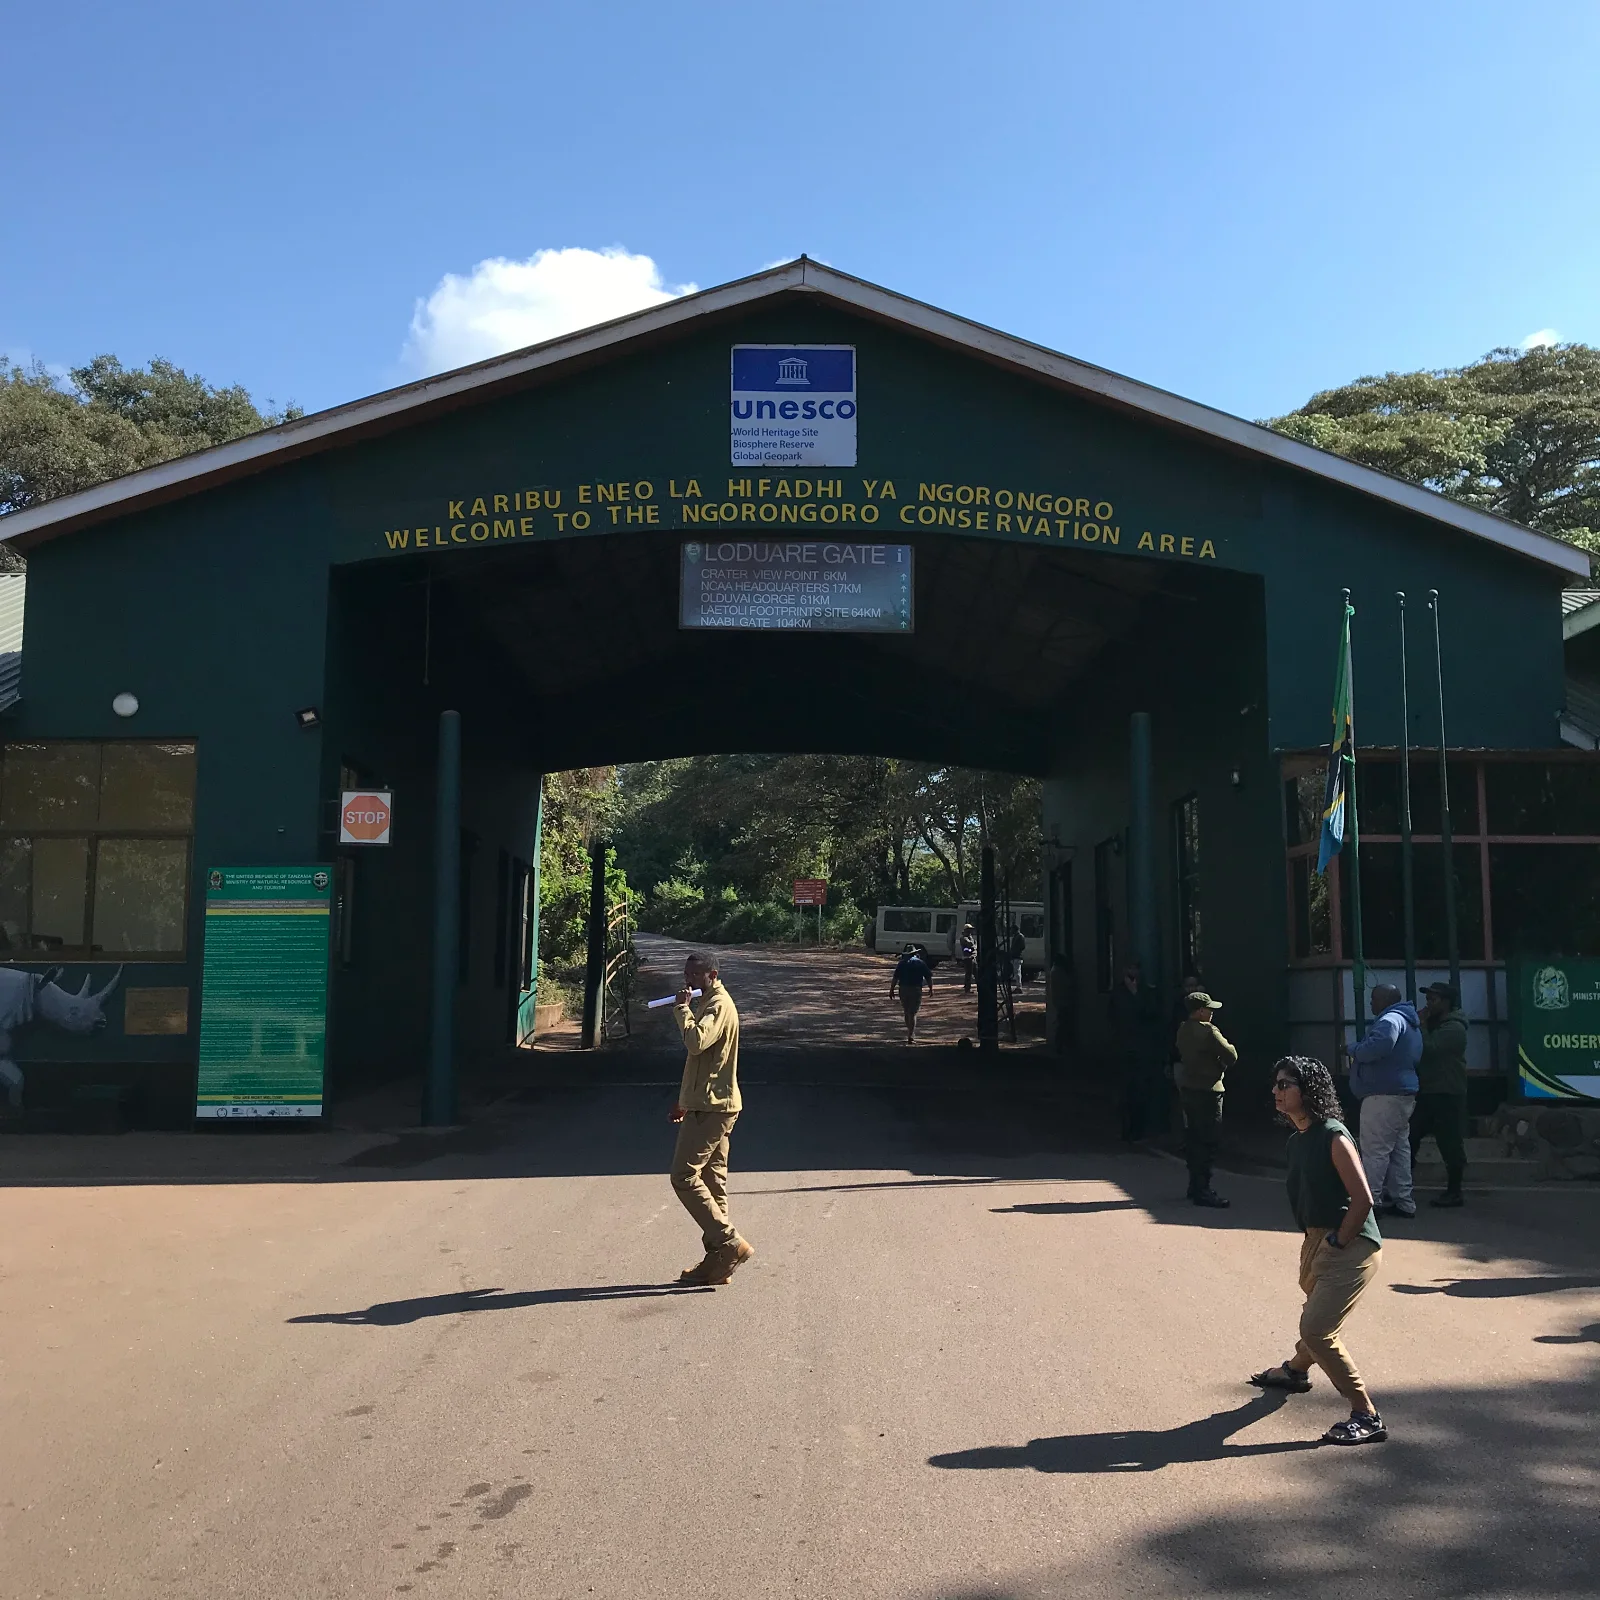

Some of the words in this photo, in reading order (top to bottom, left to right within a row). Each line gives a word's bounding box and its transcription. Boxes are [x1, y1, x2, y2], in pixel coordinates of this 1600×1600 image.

[733, 400, 856, 420] unesco
[733, 428, 759, 436] World
[762, 428, 800, 438] Heritage
[802, 428, 818, 436] Site
[734, 440, 777, 449] Biosphere
[780, 440, 814, 448] Reserve
[733, 452, 762, 460] Global
[764, 452, 802, 461] Geopark
[449, 490, 561, 519] KARIBU
[578, 480, 654, 503] ENEO
[669, 479, 702, 498] LA
[728, 479, 842, 498] HIFADHI
[862, 480, 897, 499] YA
[918, 483, 1113, 521] NGORONGORO
[384, 517, 534, 550] WELCOME
[553, 510, 591, 532] TO
[607, 505, 660, 524] THE
[682, 503, 879, 523] NGORONGORO
[900, 505, 1120, 545] CONSERVATION
[1137, 532, 1216, 559] AREA
[706, 543, 817, 562] LODUARE
[823, 545, 885, 564] GATE
[701, 568, 748, 579] CRATER
[752, 570, 782, 579] VIEW
[784, 570, 819, 580] POINT
[823, 571, 847, 580] 6KM
[701, 581, 732, 591] NCAA
[736, 582, 830, 593] HEADQUARTERS
[833, 584, 861, 593] 17KM
[701, 592, 750, 603] OLDUVAI
[752, 594, 795, 604] GORGE
[800, 595, 830, 605] 61KM
[701, 605, 746, 615] LAETOLI
[749, 606, 822, 617] FOOTPRINTS
[824, 608, 849, 617] SITE
[851, 608, 880, 617] 64KM
[700, 617, 734, 626] NAABI
[739, 617, 770, 627] GATE
[776, 618, 811, 628] 104KM
[346, 812, 386, 824] STOP
